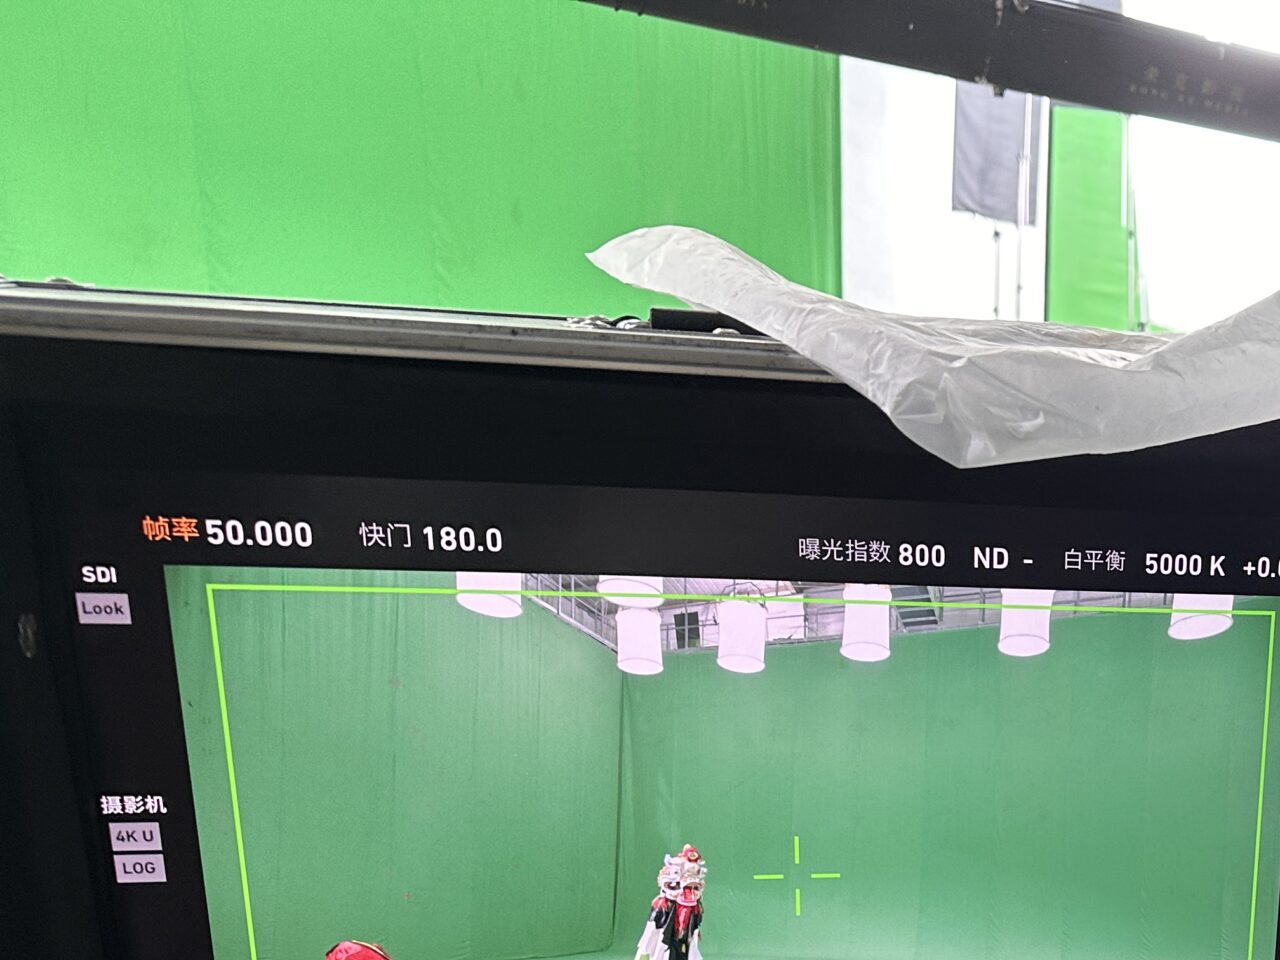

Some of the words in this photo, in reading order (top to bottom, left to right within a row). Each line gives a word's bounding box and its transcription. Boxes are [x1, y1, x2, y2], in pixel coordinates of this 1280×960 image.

[142, 515, 199, 543] 帧率
[205, 519, 313, 548] 50.000
[358, 521, 411, 548] 快门
[422, 525, 502, 552] 180.0
[798, 537, 891, 563] 曝光指数
[899, 543, 946, 567] 800
[973, 547, 1009, 570] ND
[1064, 548, 1126, 573] 白平衡
[1145, 553, 1201, 576] 5000
[1210, 555, 1226, 576] K
[82, 565, 117, 584] SDI
[82, 600, 125, 617] Look
[100, 795, 167, 815] 摄影机
[115, 829, 138, 844] 4K
[142, 829, 154, 842] U
[122, 859, 157, 876] LOG
